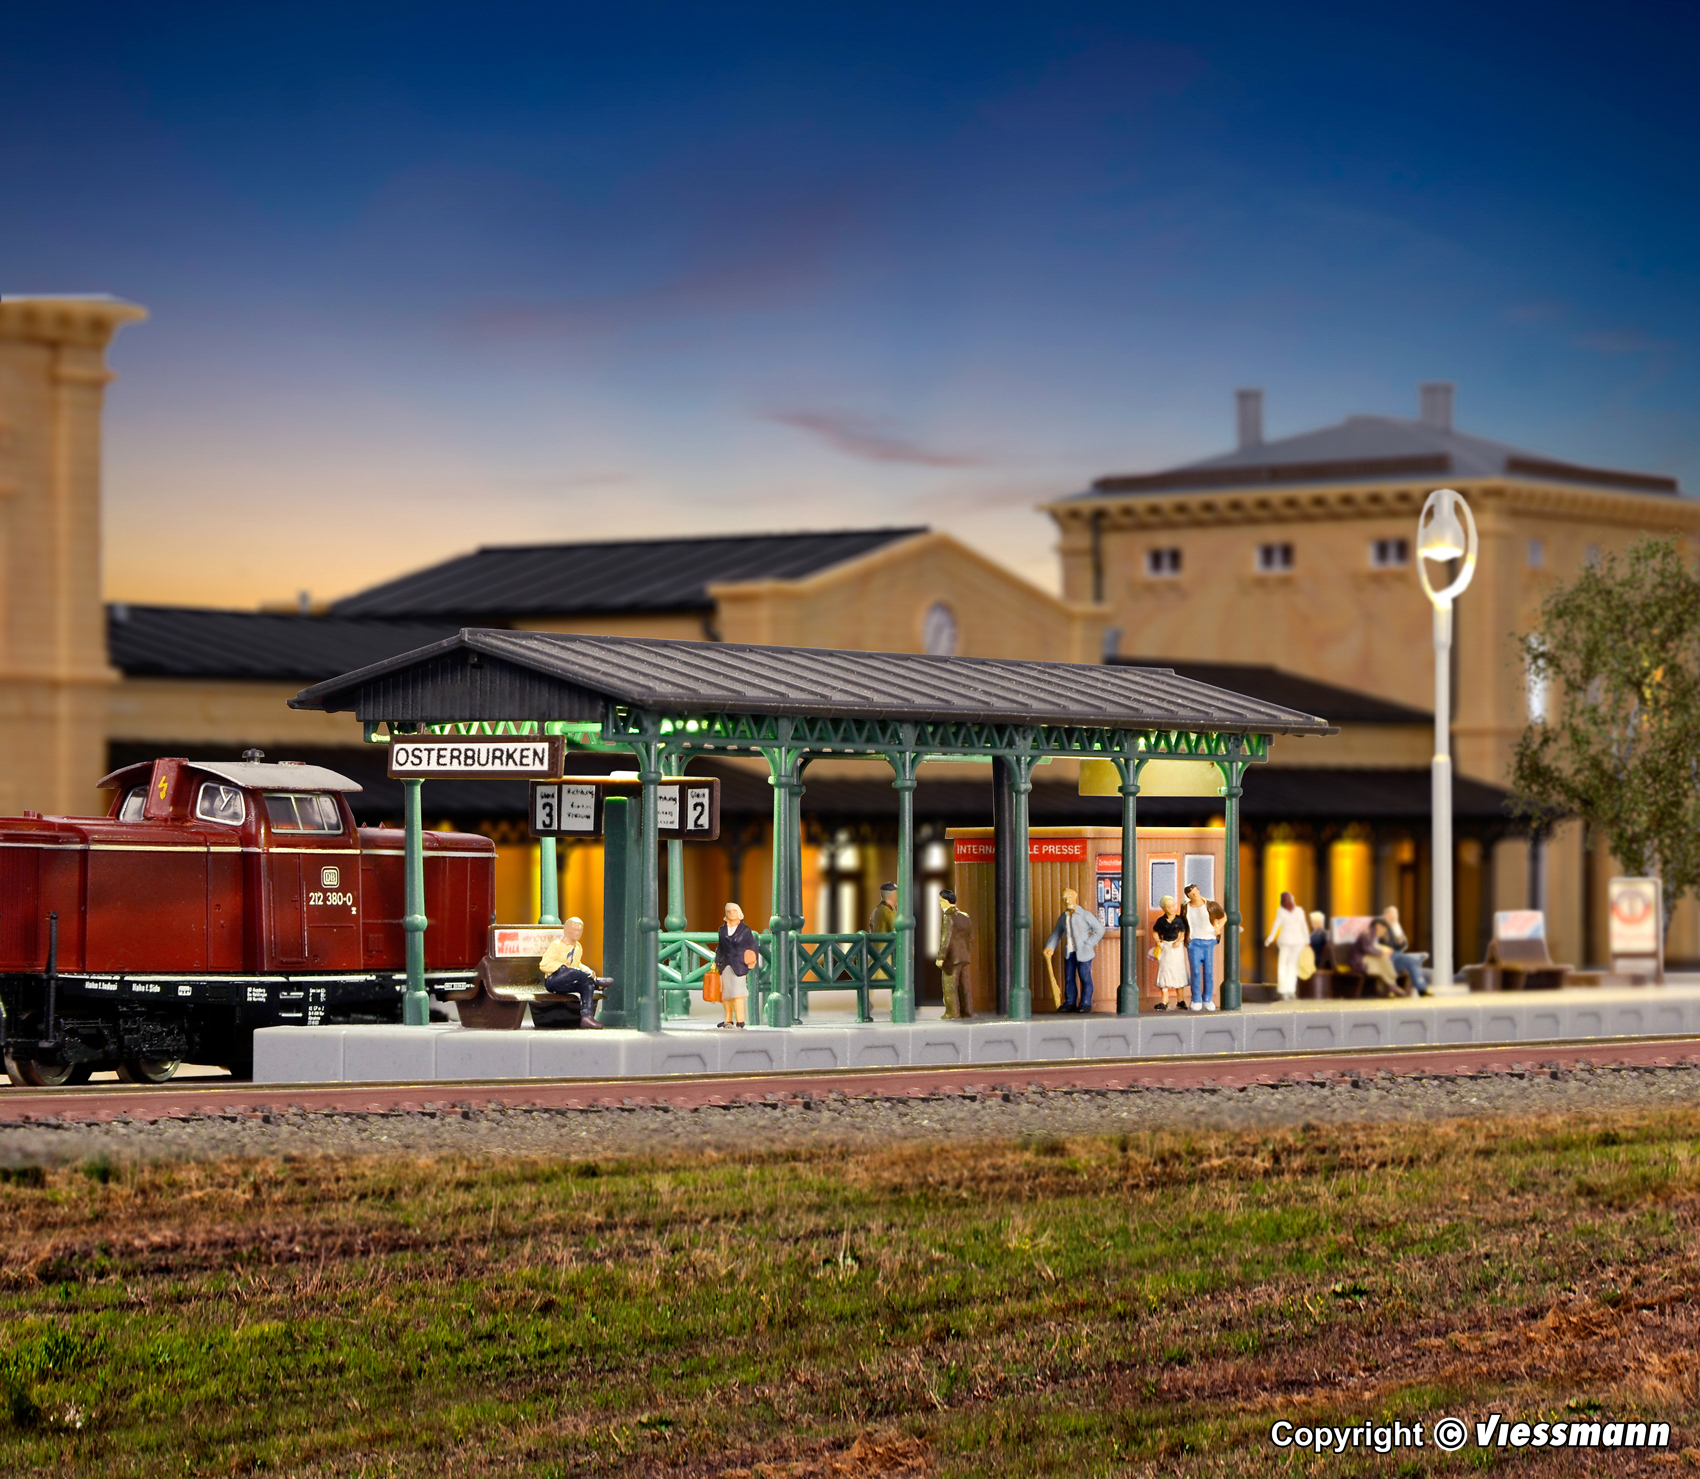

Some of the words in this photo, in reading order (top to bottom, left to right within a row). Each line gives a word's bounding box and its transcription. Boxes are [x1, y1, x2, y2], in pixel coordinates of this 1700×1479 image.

[395, 747, 546, 767] OSTERBURKEN
[542, 802, 553, 828] 3
[693, 802, 705, 828] 2
[1042, 845, 1081, 855] PRESSE
[309, 892, 324, 905] 212
[326, 892, 353, 906] 380-0
